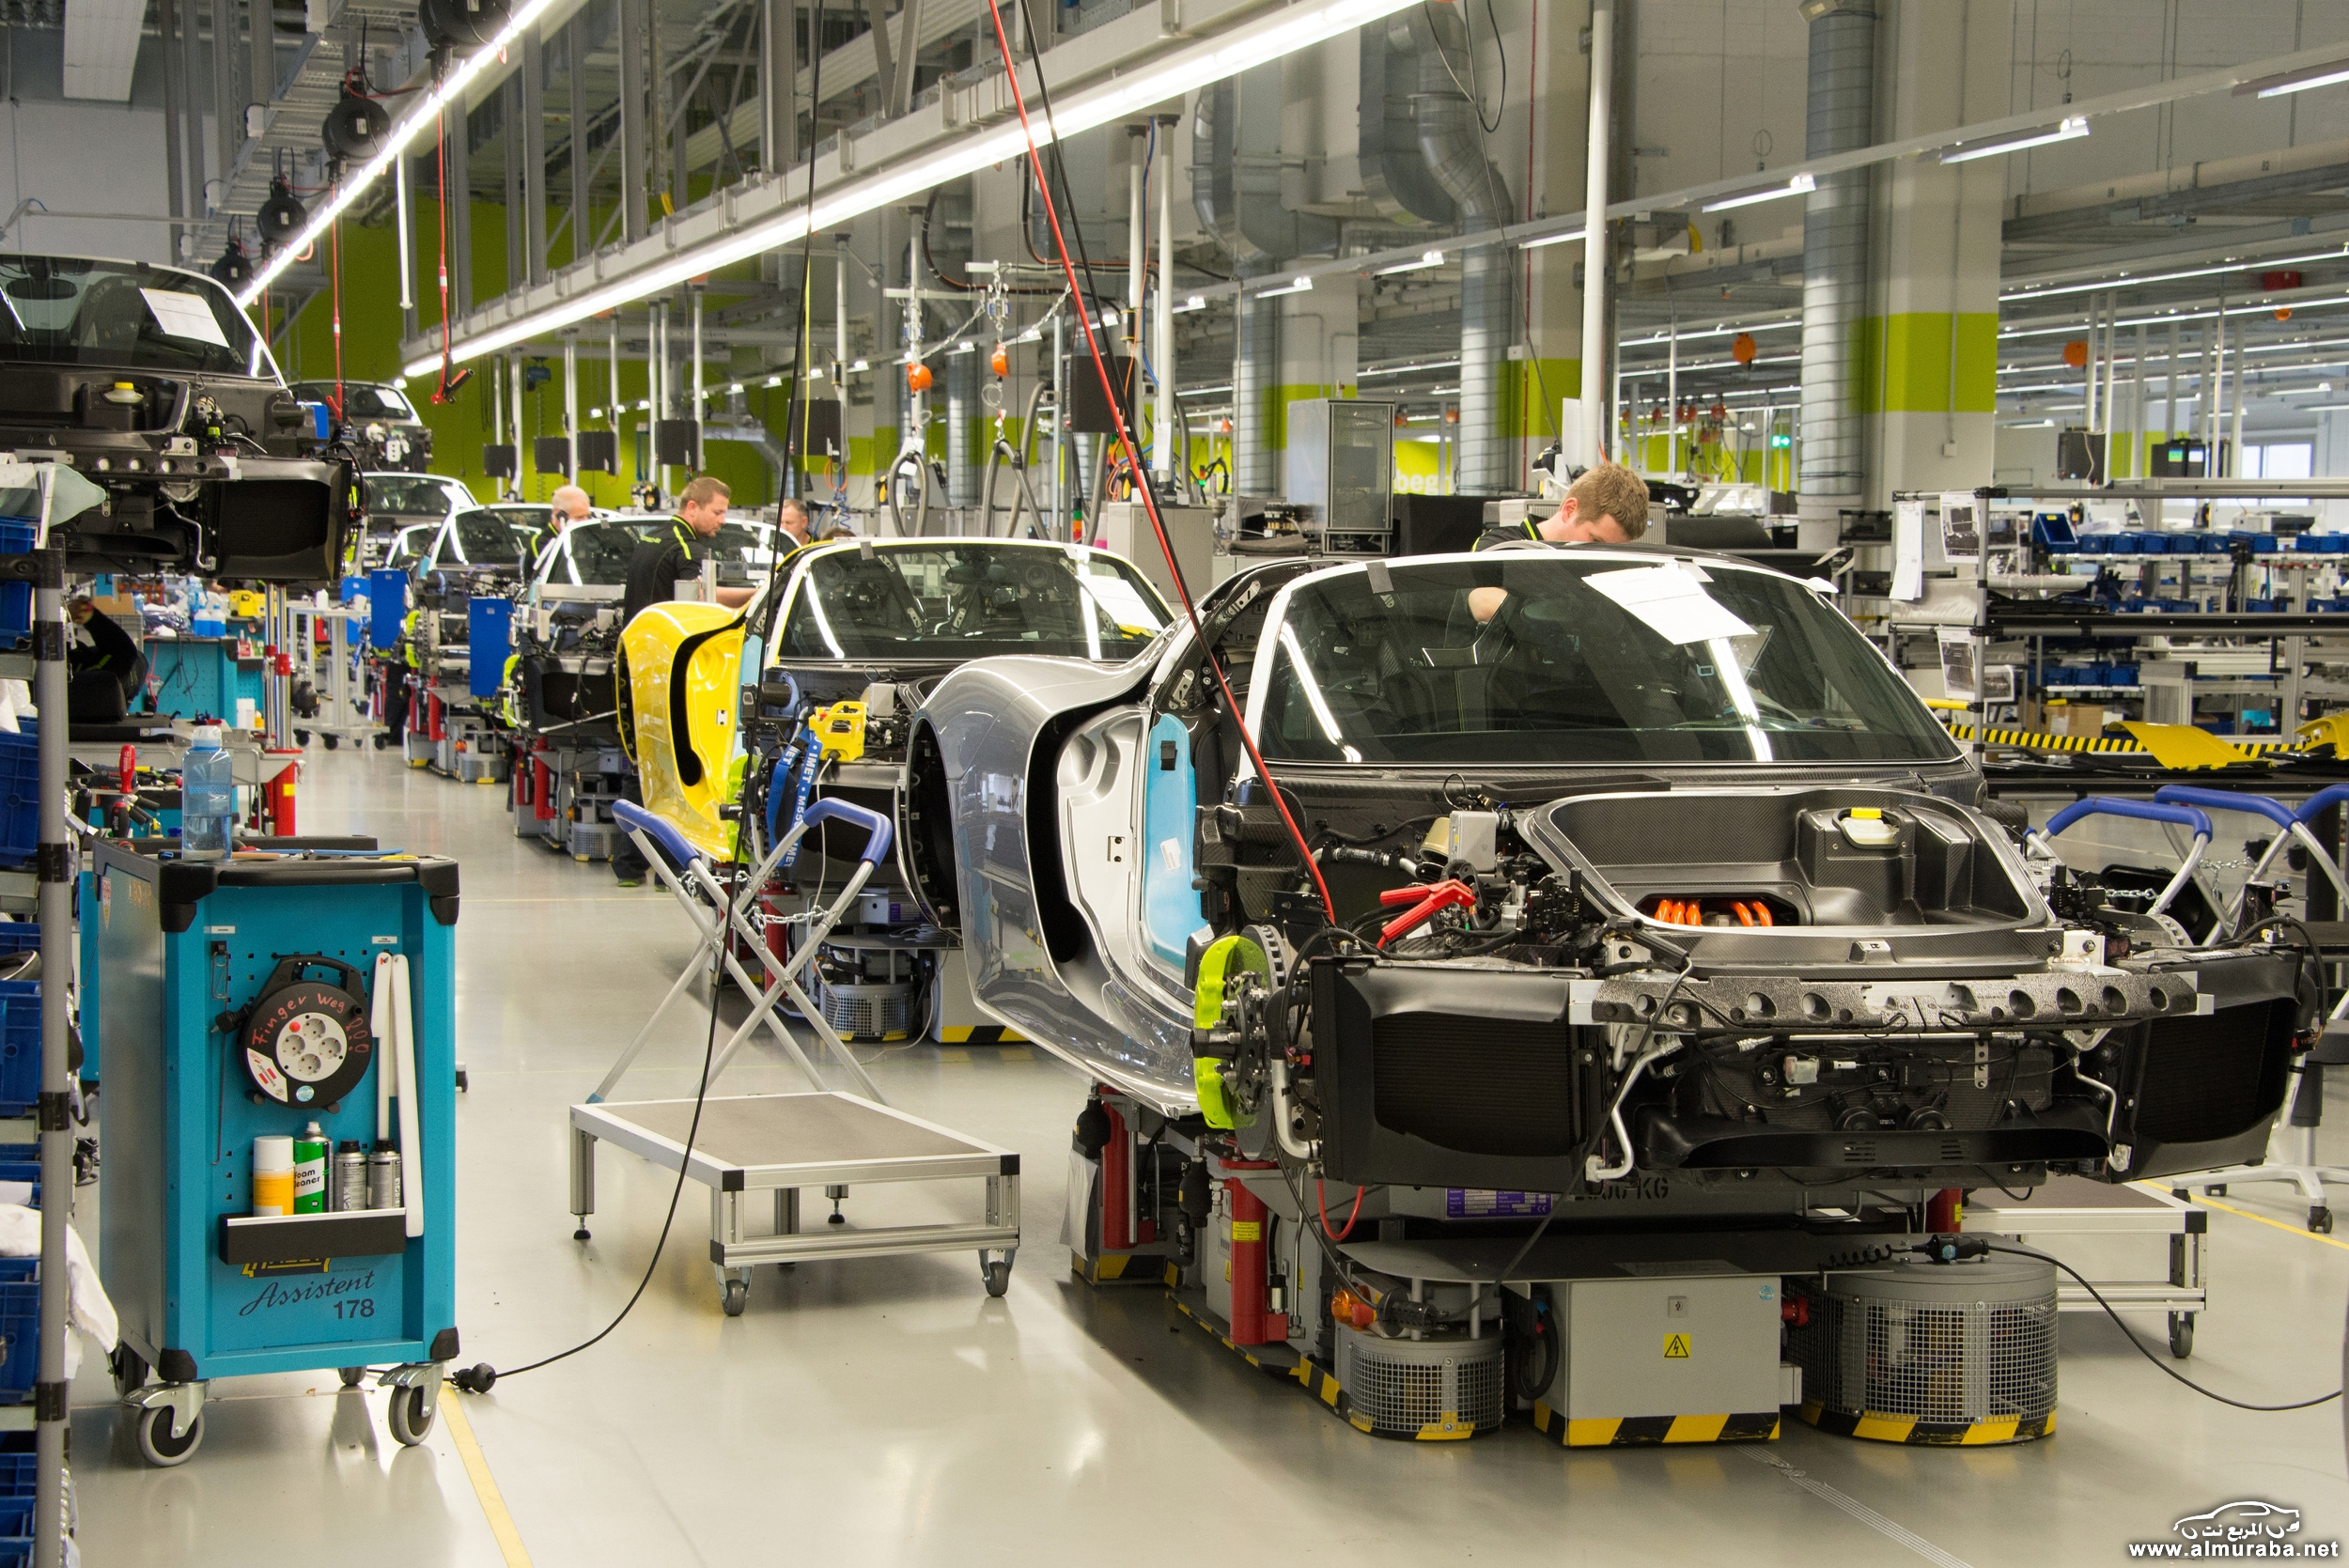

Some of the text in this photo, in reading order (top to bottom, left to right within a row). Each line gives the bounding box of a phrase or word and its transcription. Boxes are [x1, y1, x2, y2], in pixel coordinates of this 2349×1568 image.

[782, 745, 800, 765] MET
[801, 753, 818, 784] IMET
[252, 996, 306, 1046] Finger
[317, 993, 345, 1014] Weg
[1637, 1176, 1669, 1200] KG
[239, 1270, 375, 1316] Assistent
[333, 1298, 375, 1319] 178
